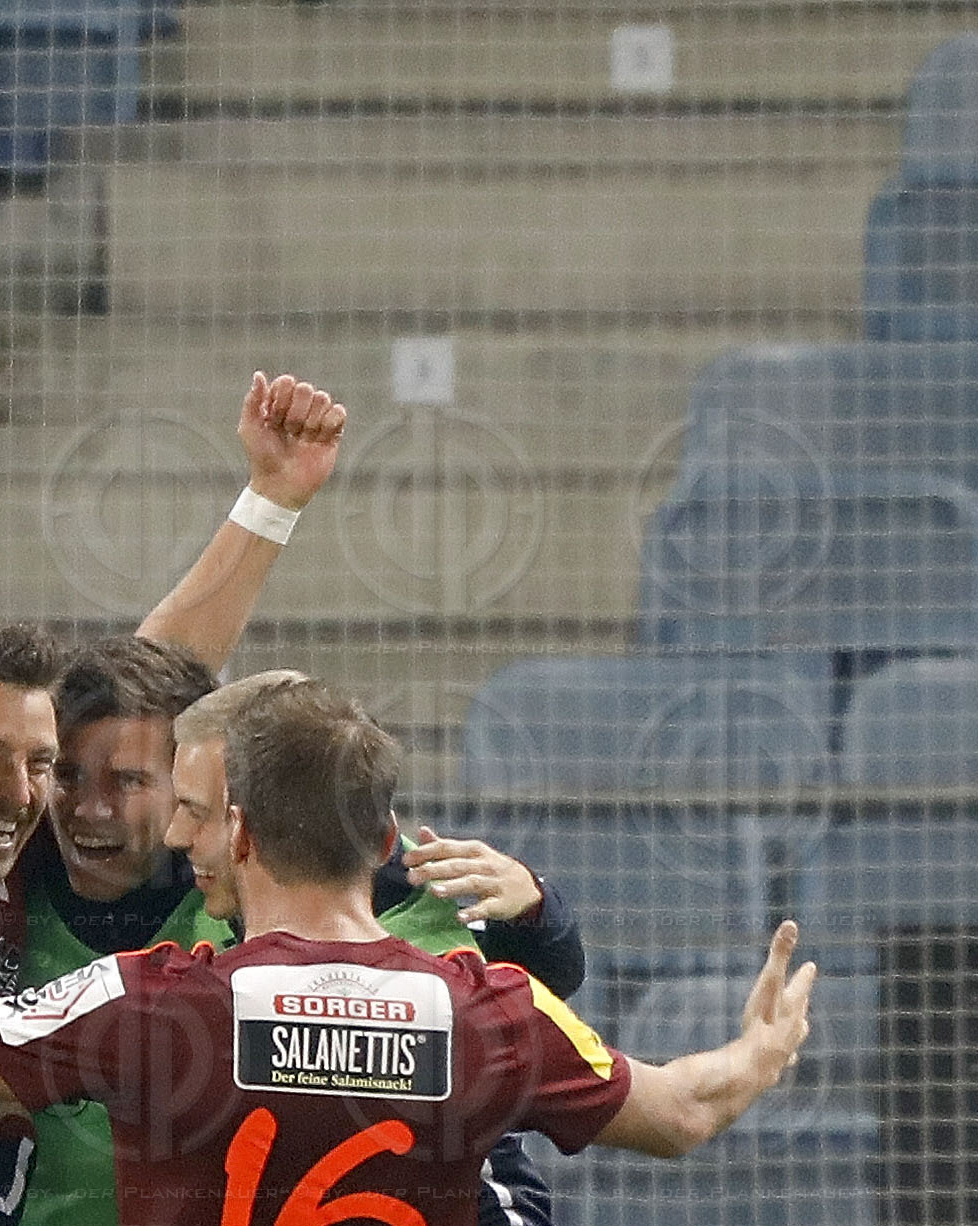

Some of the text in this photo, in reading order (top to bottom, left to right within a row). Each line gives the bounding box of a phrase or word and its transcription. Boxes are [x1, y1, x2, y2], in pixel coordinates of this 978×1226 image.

[281, 996, 408, 1020] SORGER
[272, 1070, 412, 1091] Der feine Salamisnack!
